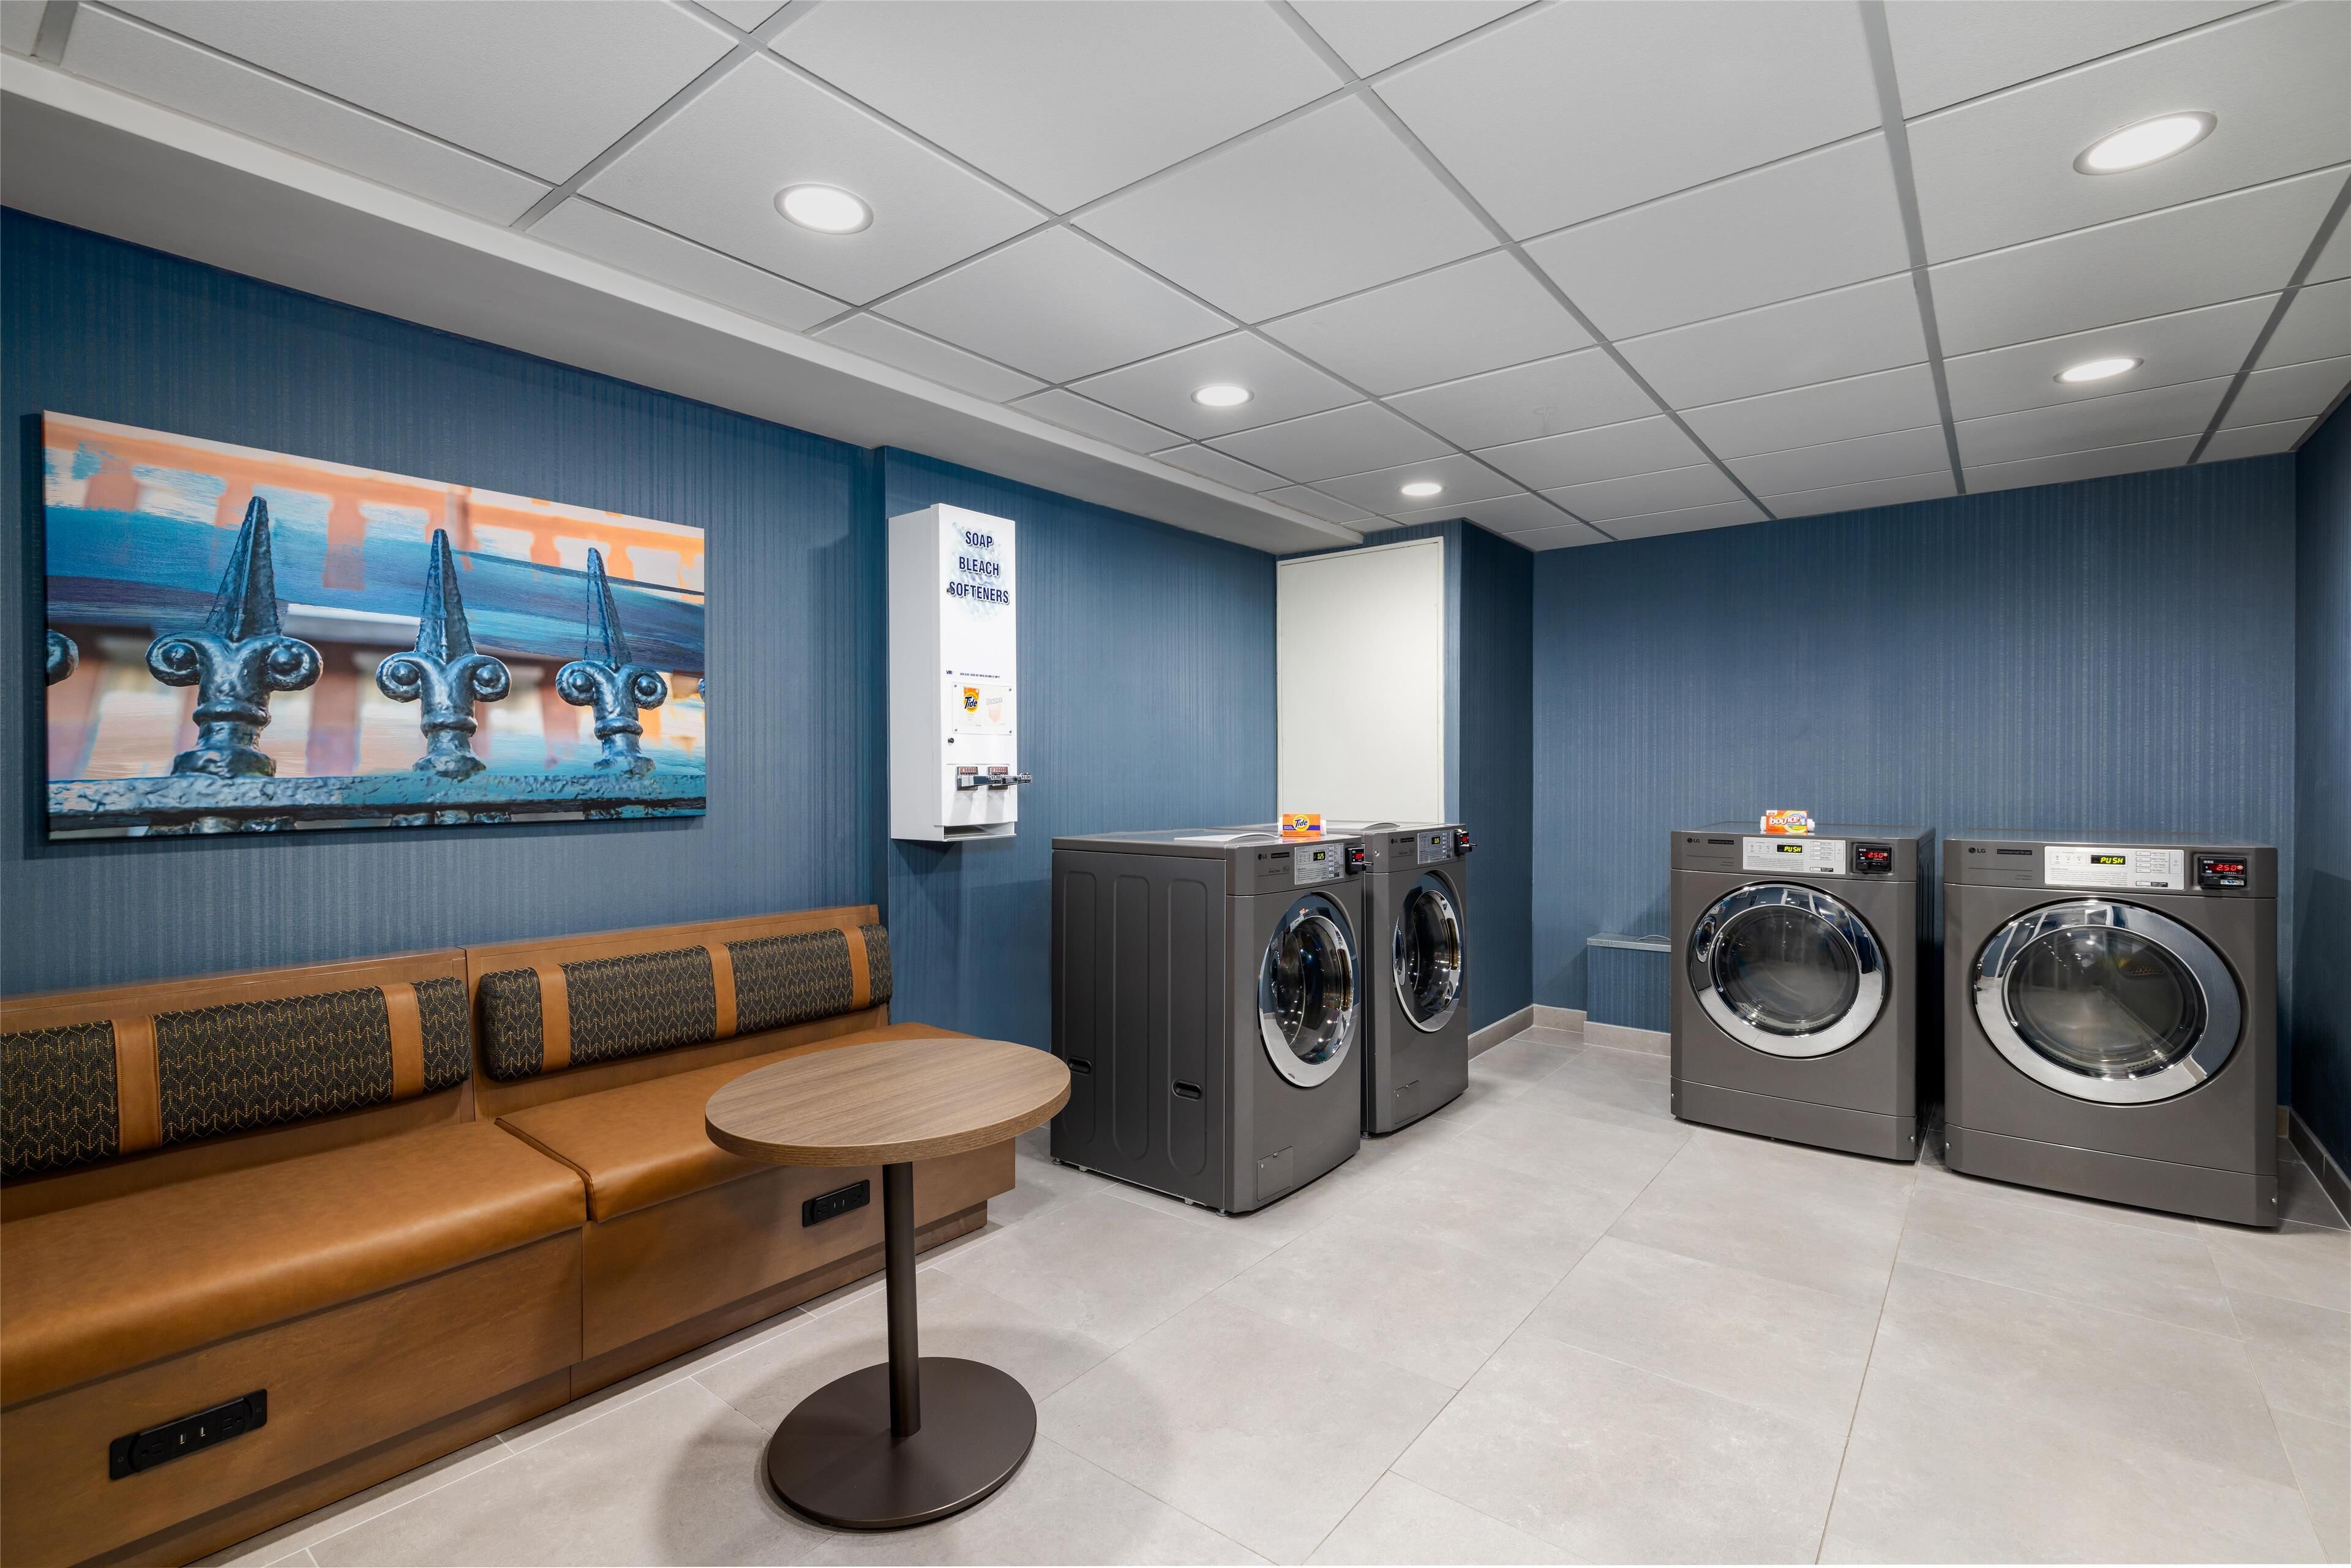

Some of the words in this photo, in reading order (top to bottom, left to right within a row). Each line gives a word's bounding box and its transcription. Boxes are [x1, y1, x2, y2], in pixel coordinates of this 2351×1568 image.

[965, 531, 993, 548] SOAP
[959, 556, 999, 576] BLEACH
[949, 581, 1009, 604] SOFTENERS
[964, 696, 978, 709] Tide
[1295, 819, 1308, 828] Tide
[1769, 816, 1801, 825] bounce
